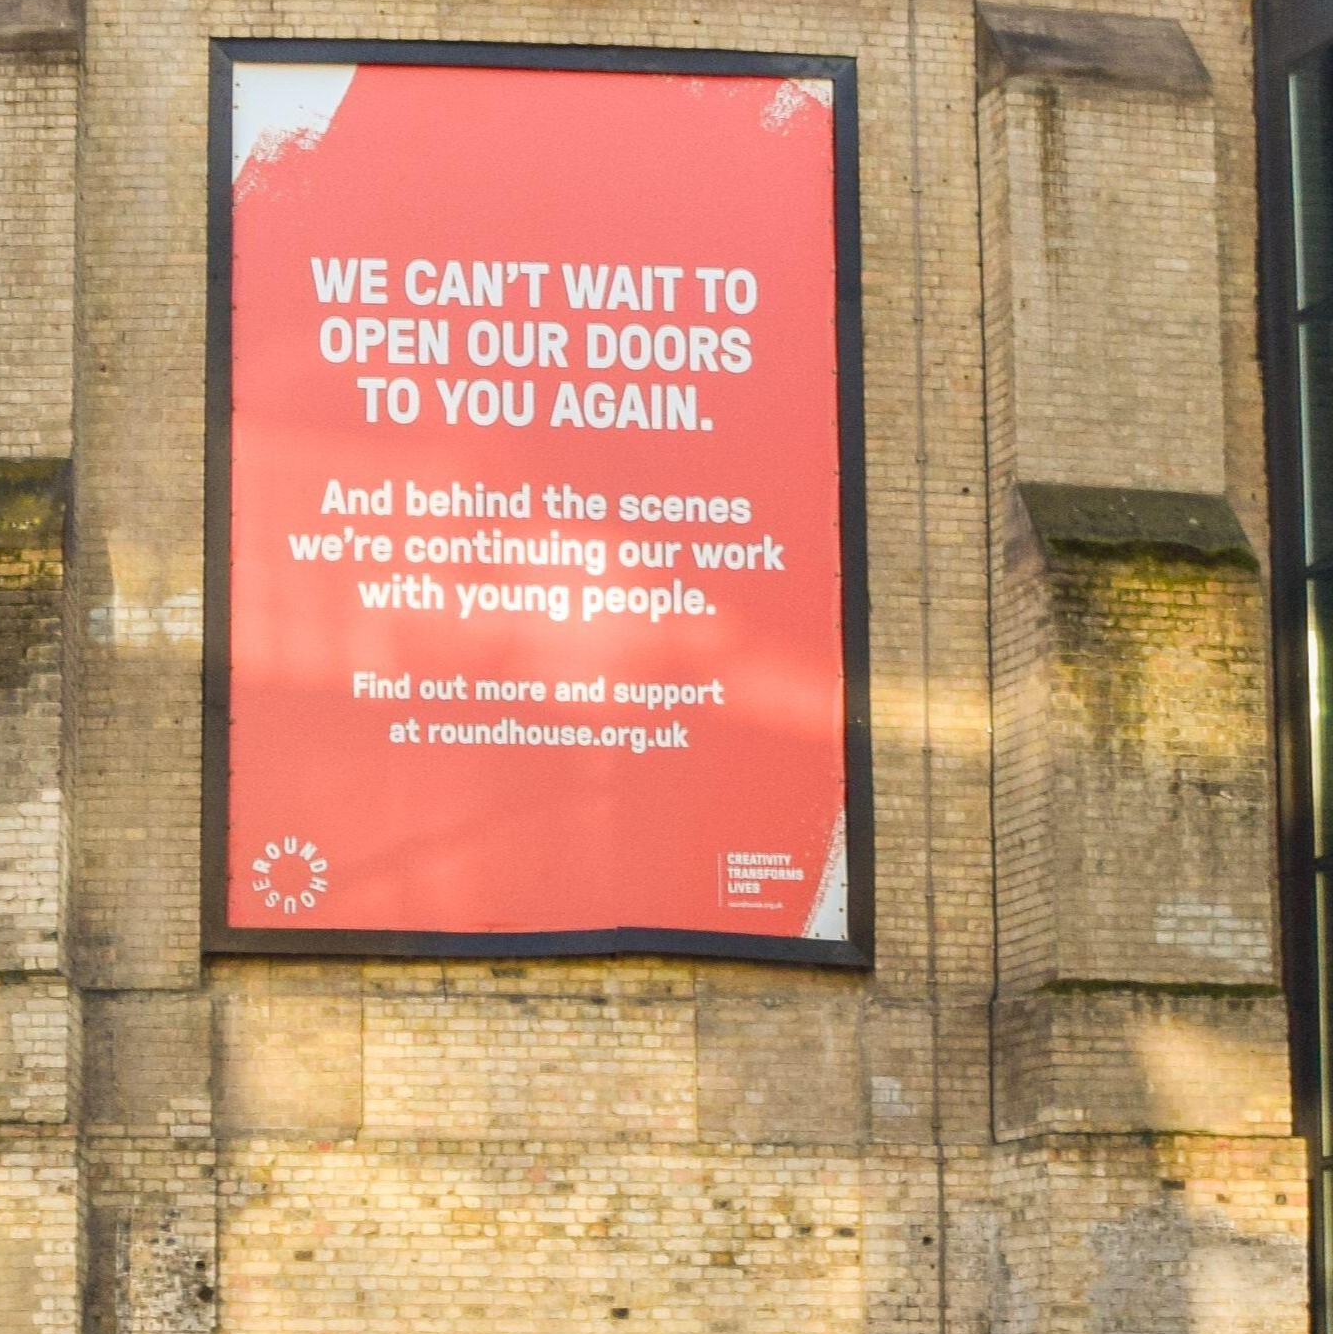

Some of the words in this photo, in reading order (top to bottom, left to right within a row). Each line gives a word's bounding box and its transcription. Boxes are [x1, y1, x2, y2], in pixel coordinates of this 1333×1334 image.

[311, 257, 387, 303] WE
[405, 259, 549, 307] CAN'T
[562, 264, 683, 311] WAIT
[696, 268, 757, 314] TO
[320, 317, 449, 364] OPEN
[468, 320, 568, 367] OUR
[587, 323, 752, 373] DOORS
[357, 377, 420, 424] TO
[436, 379, 534, 426] YOU
[551, 382, 712, 430] AGAIN.
[321, 480, 392, 515] And
[406, 481, 530, 518] behind
[542, 485, 607, 520] the
[619, 495, 751, 523] scenes
[288, 526, 392, 562] we're
[405, 529, 606, 576] continuing
[618, 541, 681, 567] our
[692, 535, 784, 570] work
[358, 574, 444, 609] with
[456, 585, 570, 621] young
[582, 580, 715, 622] people.
[353, 671, 410, 699] Find
[420, 674, 468, 700] out
[476, 681, 546, 701] more
[555, 676, 605, 702] and
[614, 679, 724, 710] support
[389, 719, 420, 743] at
[428, 719, 688, 753] roundhouse.org.uk
[252, 835, 328, 915] ROUNDHOUSE
[727, 853, 791, 865] CREATIVITY
[727, 868, 804, 880] TRANSFORMS
[727, 882, 761, 894] LIVES
